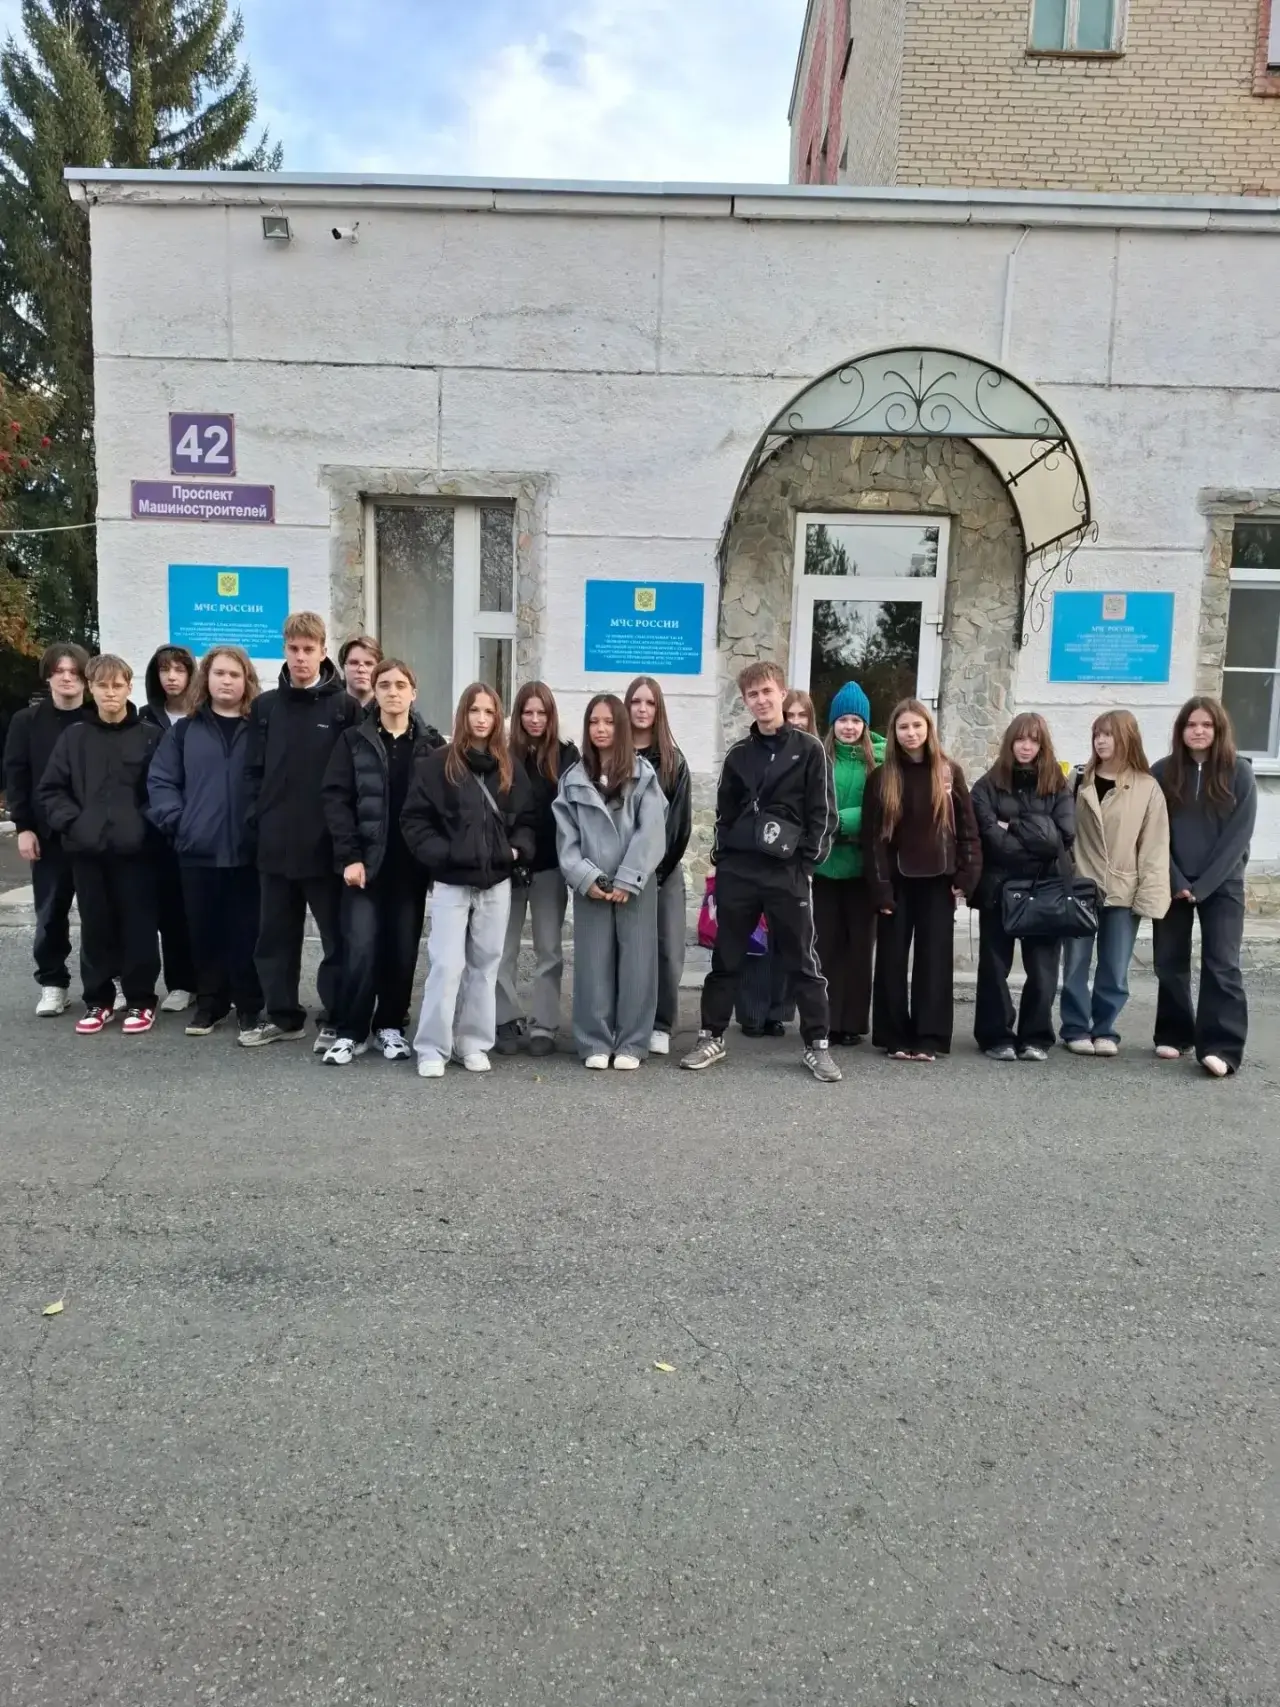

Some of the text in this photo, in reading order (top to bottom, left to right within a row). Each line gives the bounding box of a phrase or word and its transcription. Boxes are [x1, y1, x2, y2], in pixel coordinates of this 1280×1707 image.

[176, 424, 229, 464] 42
[172, 485, 234, 502] Проспект
[139, 499, 267, 518] Машиностроителей
[194, 603, 263, 613] МЧС РОССИИ
[610, 618, 679, 628] МЧС РОССИИ
